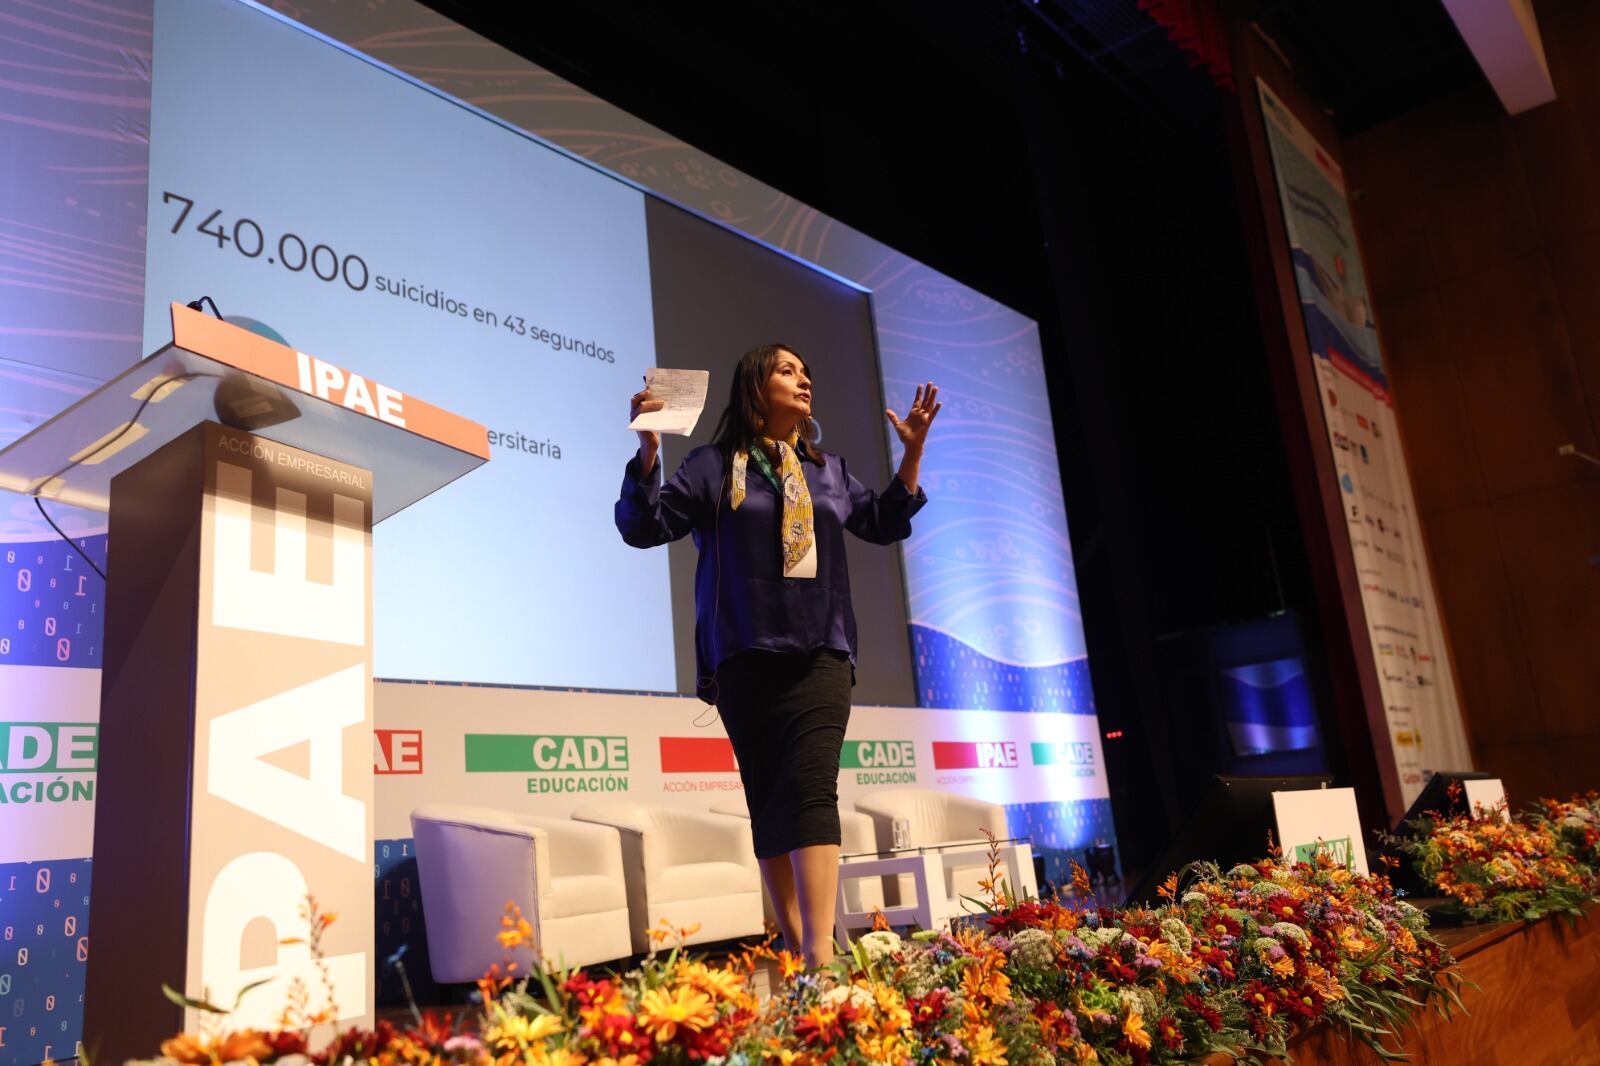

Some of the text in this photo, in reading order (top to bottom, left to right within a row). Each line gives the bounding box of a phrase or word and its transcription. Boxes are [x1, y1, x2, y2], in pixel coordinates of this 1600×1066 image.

[162, 191, 616, 364] 740.000 suicidios en 43 segundos
[296, 351, 407, 429] IPAE
[487, 429, 562, 460] ersitaria
[277, 451, 367, 490] EMPRESARIAL
[0, 726, 97, 770] DE
[533, 736, 629, 770] CADE
[857, 741, 915, 767] CADE
[976, 743, 1018, 768] IPAE
[526, 773, 629, 794] EDUCACIÓN
[662, 779, 698, 793] ACCIÓN
[856, 770, 917, 785] EDUCACIÓN
